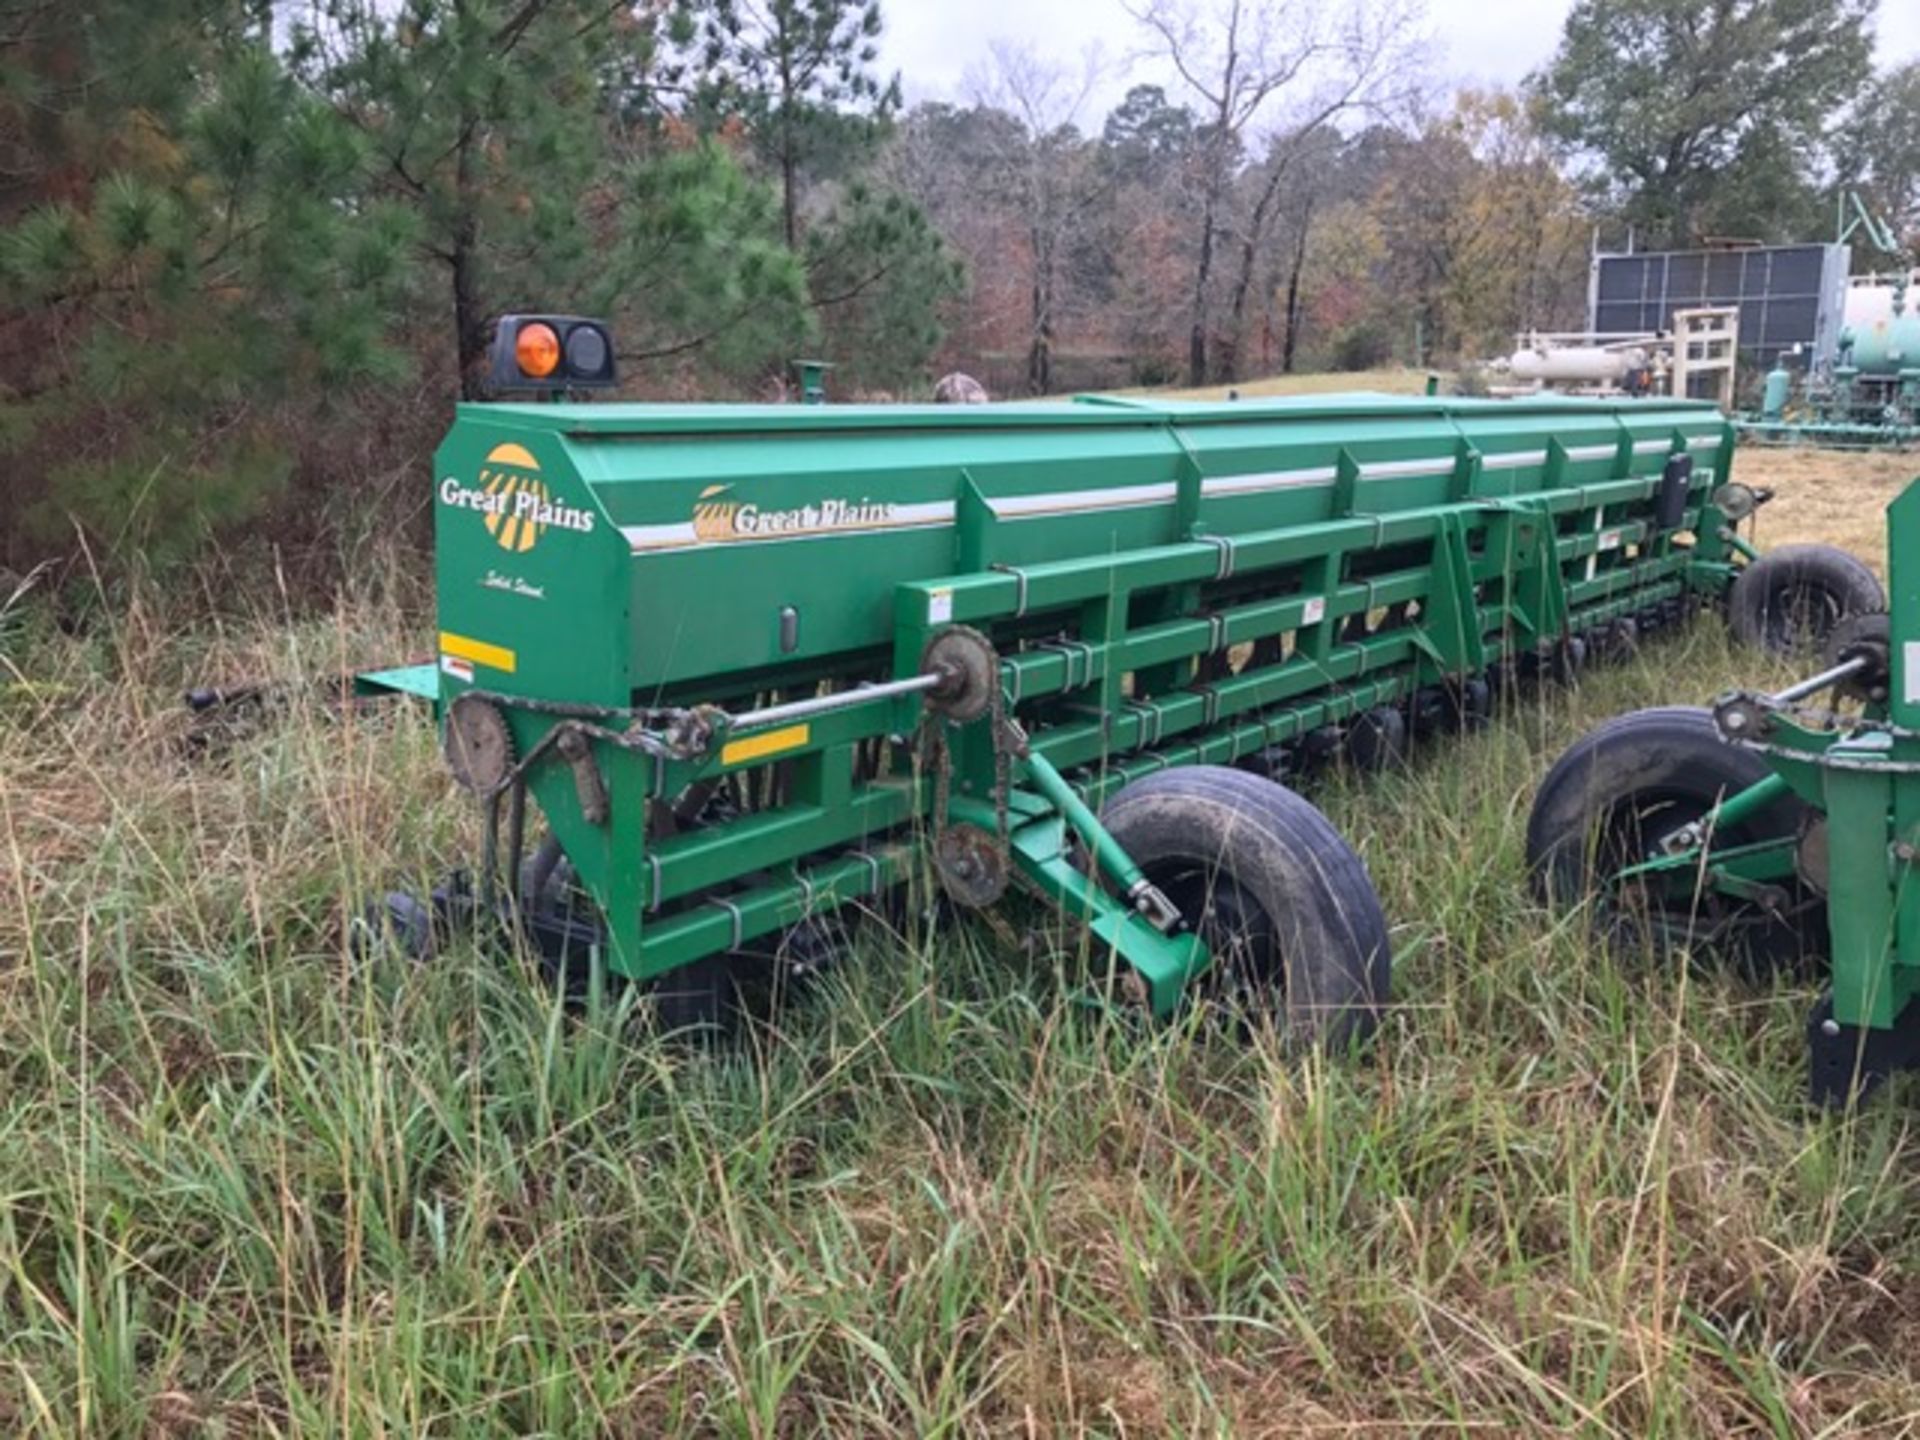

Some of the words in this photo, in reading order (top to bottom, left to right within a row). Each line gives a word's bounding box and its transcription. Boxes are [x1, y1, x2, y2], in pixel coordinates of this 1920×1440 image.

[440, 478, 507, 514] Great
[514, 490, 595, 532] Plains
[734, 503, 816, 533] Great
[816, 497, 896, 526] Plains
